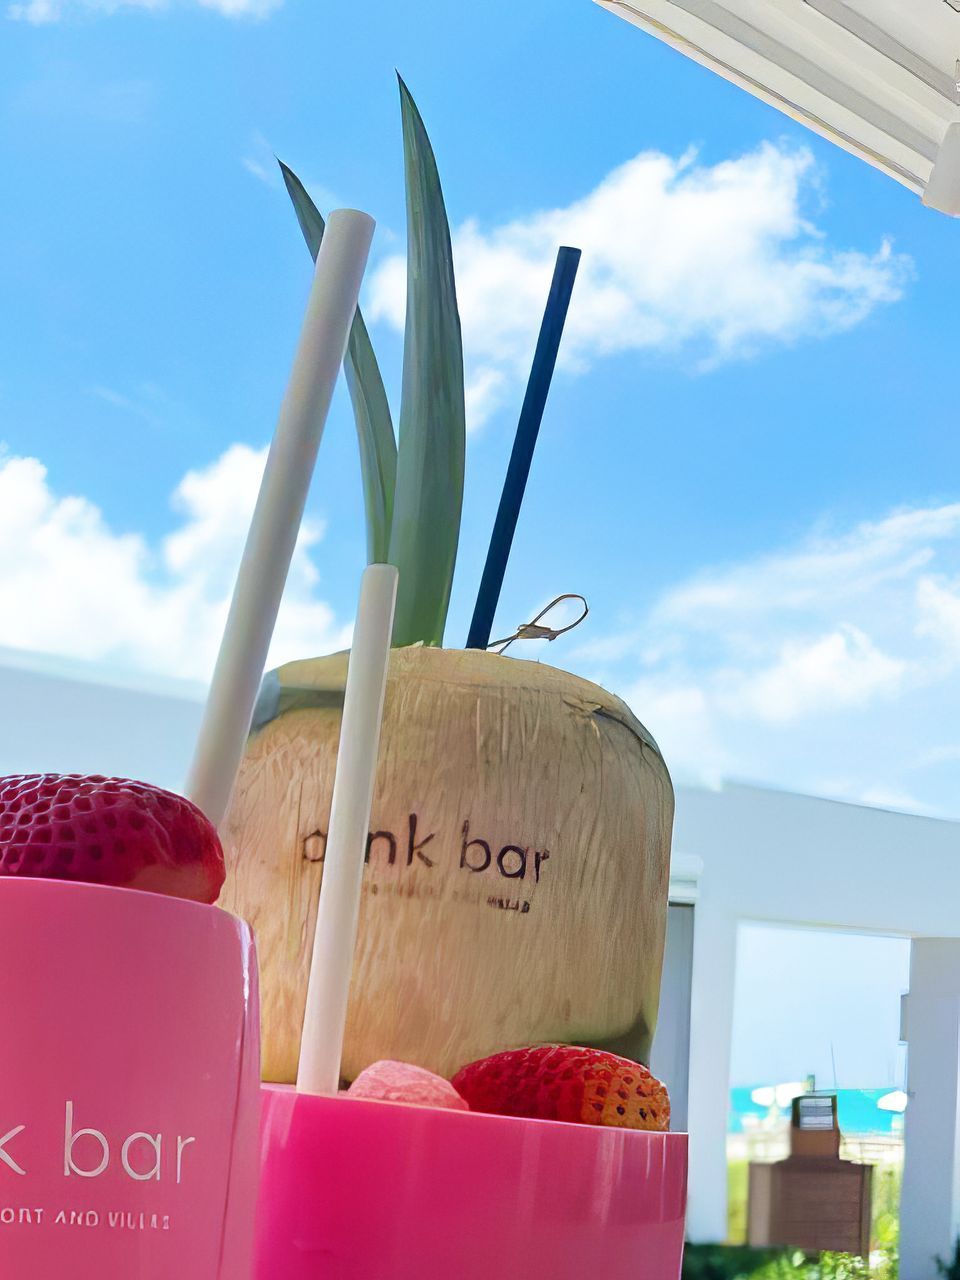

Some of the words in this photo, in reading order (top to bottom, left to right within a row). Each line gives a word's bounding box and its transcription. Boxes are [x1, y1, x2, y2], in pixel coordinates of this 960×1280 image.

[459, 818, 550, 883] bar
[63, 1100, 195, 1184] bar
[54, 1210, 99, 1227] AND
